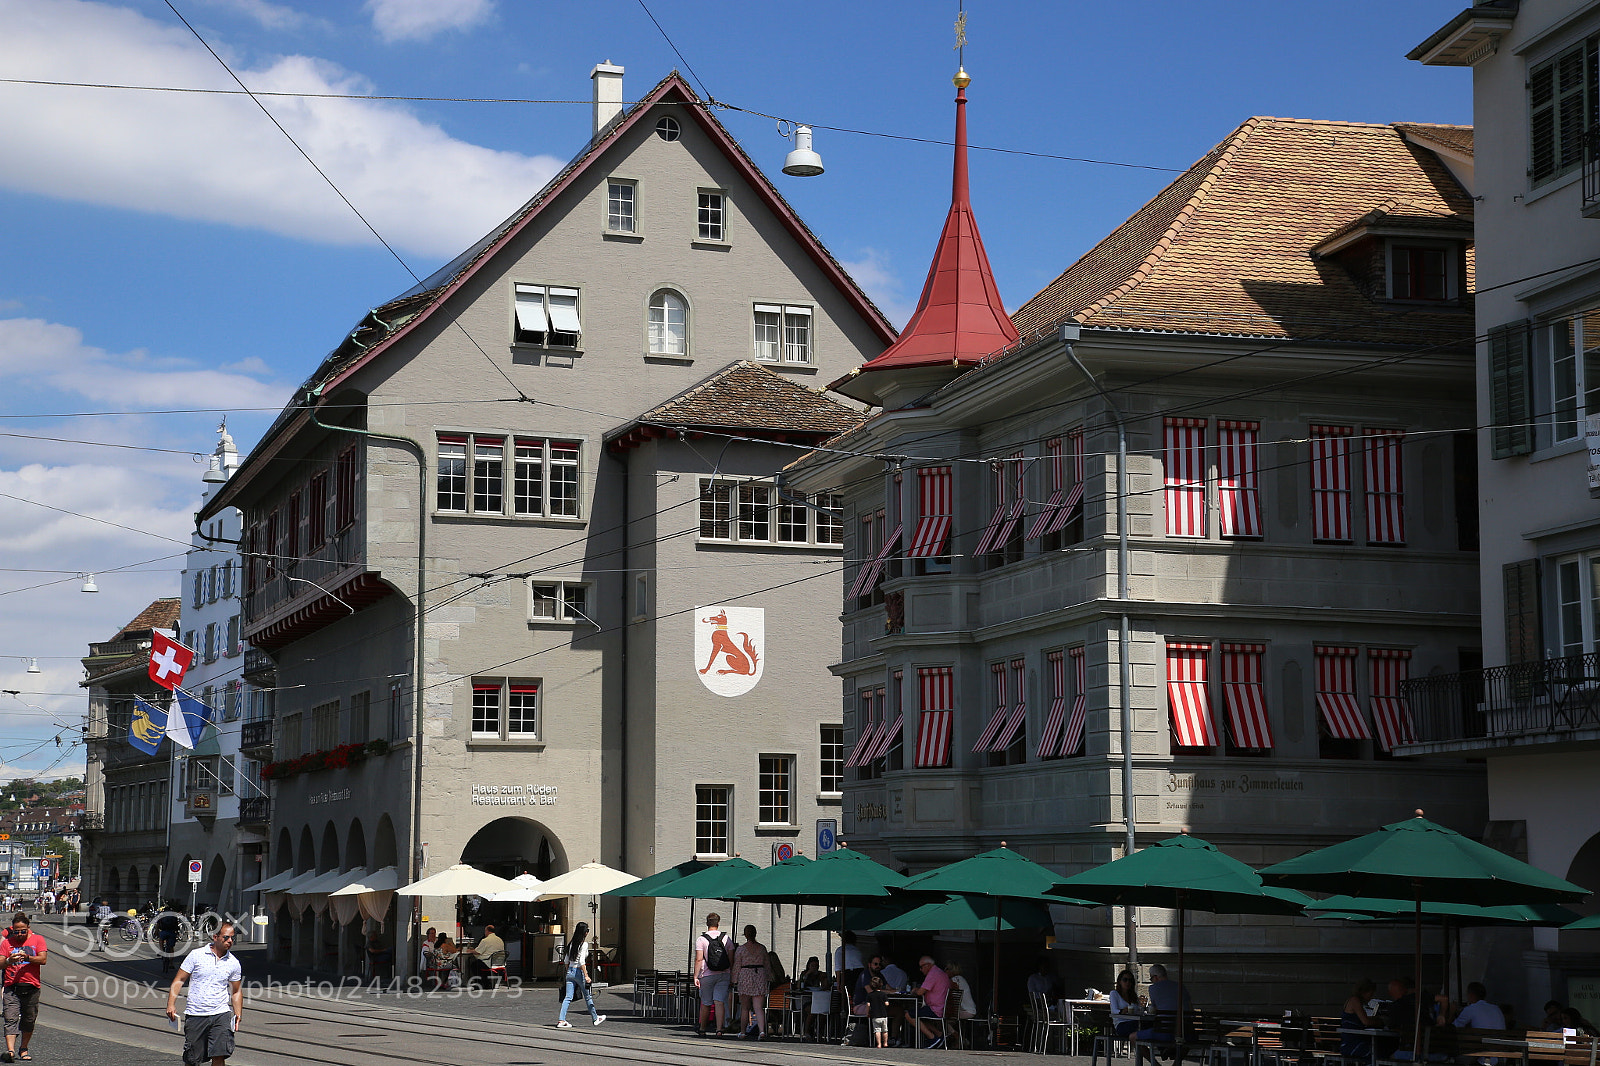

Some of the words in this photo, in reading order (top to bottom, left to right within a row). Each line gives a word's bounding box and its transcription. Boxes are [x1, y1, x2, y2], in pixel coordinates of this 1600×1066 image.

[1166, 773, 1216, 793] Zunfthaus
[1220, 780, 1236, 793] zur
[471, 784, 498, 795] Haus
[501, 786, 523, 795] zum
[526, 784, 558, 795] Rüden
[471, 795, 527, 806] Restaurant
[529, 795, 537, 806] &
[540, 795, 558, 806] Bar
